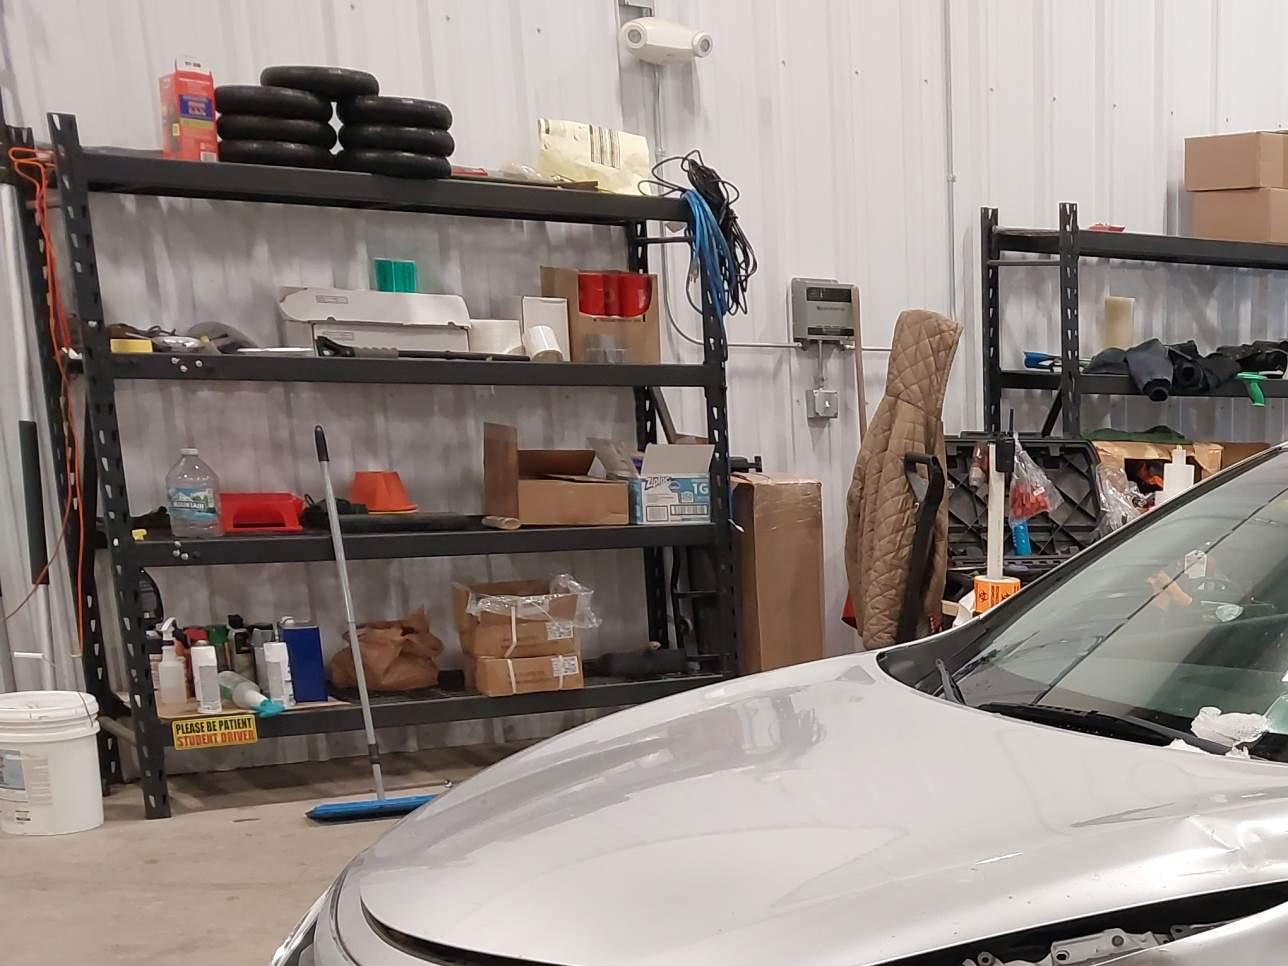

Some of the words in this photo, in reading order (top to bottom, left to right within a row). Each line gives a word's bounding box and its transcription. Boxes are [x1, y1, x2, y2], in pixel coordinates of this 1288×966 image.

[176, 722, 205, 734] PLEASE
[206, 720, 217, 732] BE
[219, 718, 252, 731] PATIENT
[176, 733, 218, 747] STUDENT
[220, 730, 255, 743] DRIVER
